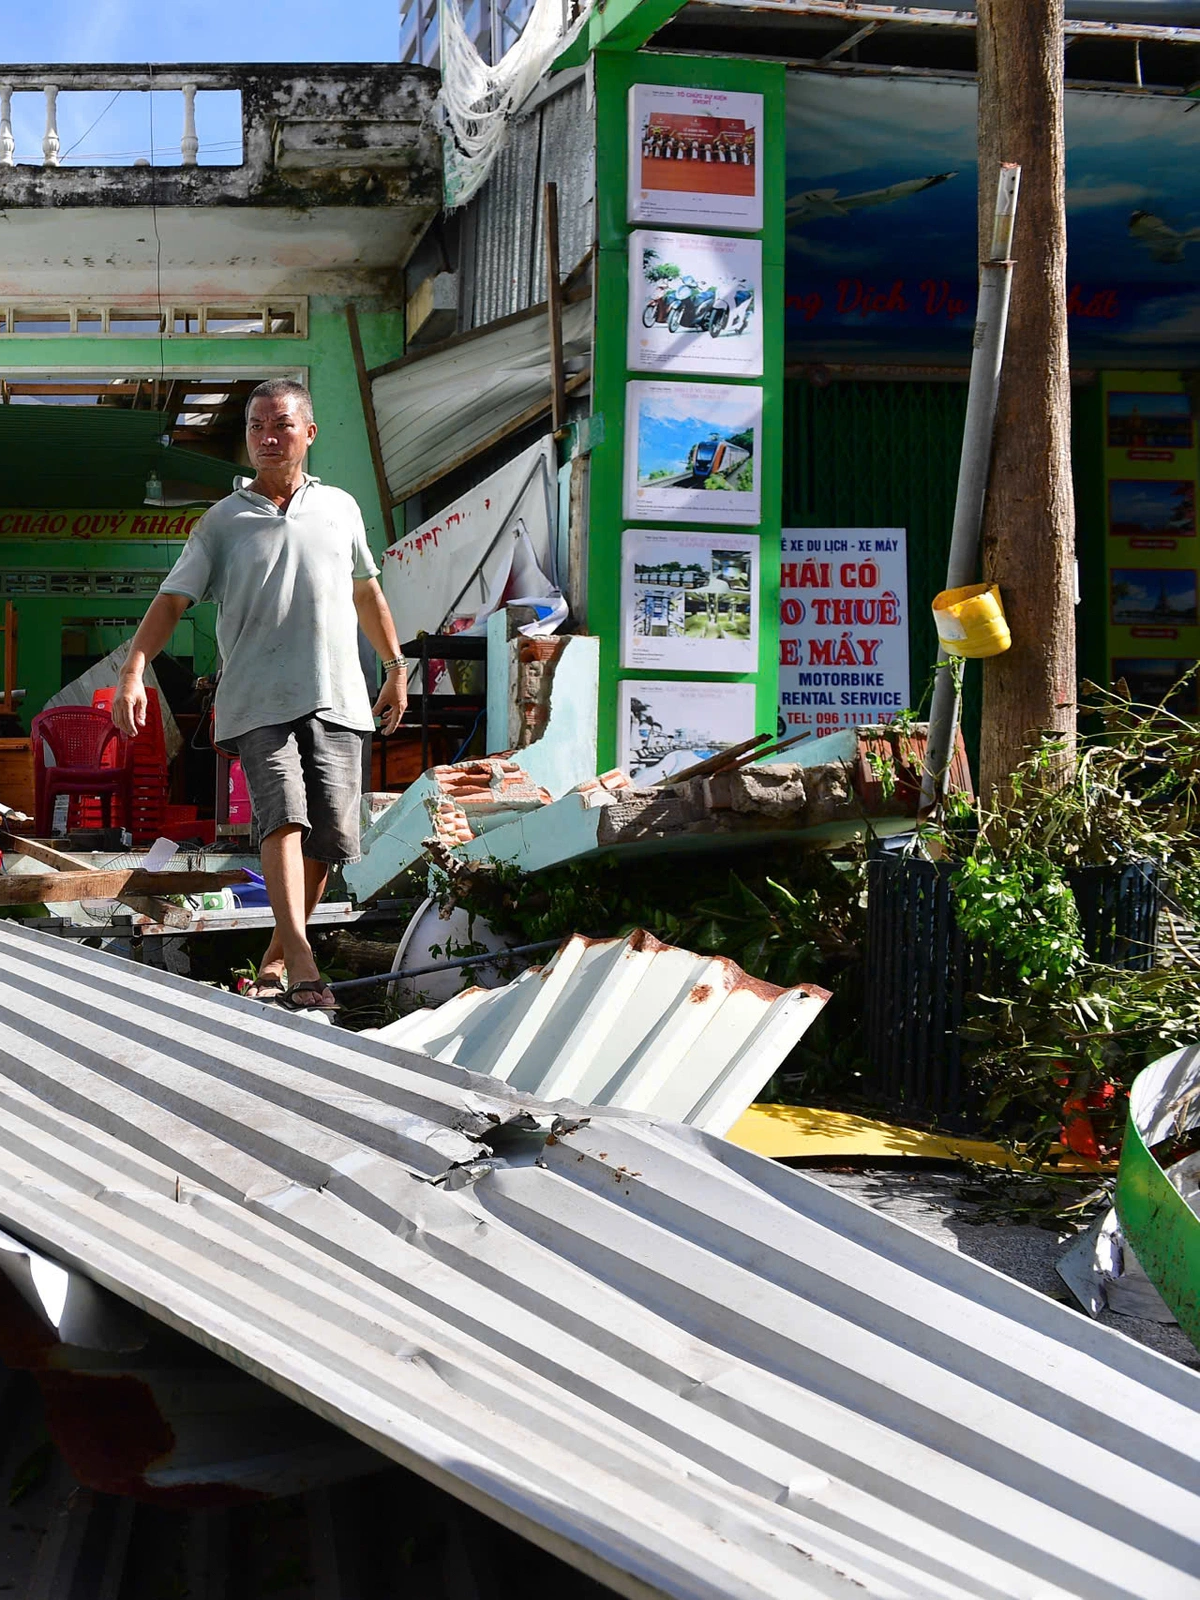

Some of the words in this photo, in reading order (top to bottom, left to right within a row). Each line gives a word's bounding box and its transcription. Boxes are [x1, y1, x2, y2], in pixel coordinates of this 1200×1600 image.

[784, 295, 824, 321] ng
[836, 278, 912, 317] Dịch
[919, 277, 969, 316] Vụ
[1065, 282, 1120, 319] hất
[71, 510, 129, 539] QUÝ
[130, 510, 202, 535] KHÁC
[790, 540, 805, 552] XE
[807, 540, 821, 552] DU
[824, 540, 848, 554] LỊCH
[858, 540, 872, 552] XE
[875, 537, 898, 552] MÁY
[781, 557, 832, 588] HÁI
[840, 557, 879, 588] CÓ
[780, 599, 806, 626] O
[810, 590, 901, 626] THUÊ
[780, 638, 803, 666] E
[808, 631, 883, 666] MÁY
[798, 672, 885, 687] MOTORBIKE
[781, 691, 836, 706] RENTAL
[840, 691, 902, 706] SERVICE
[787, 712, 812, 724] TEL:
[816, 712, 839, 724] 096
[843, 712, 873, 724] 1111
